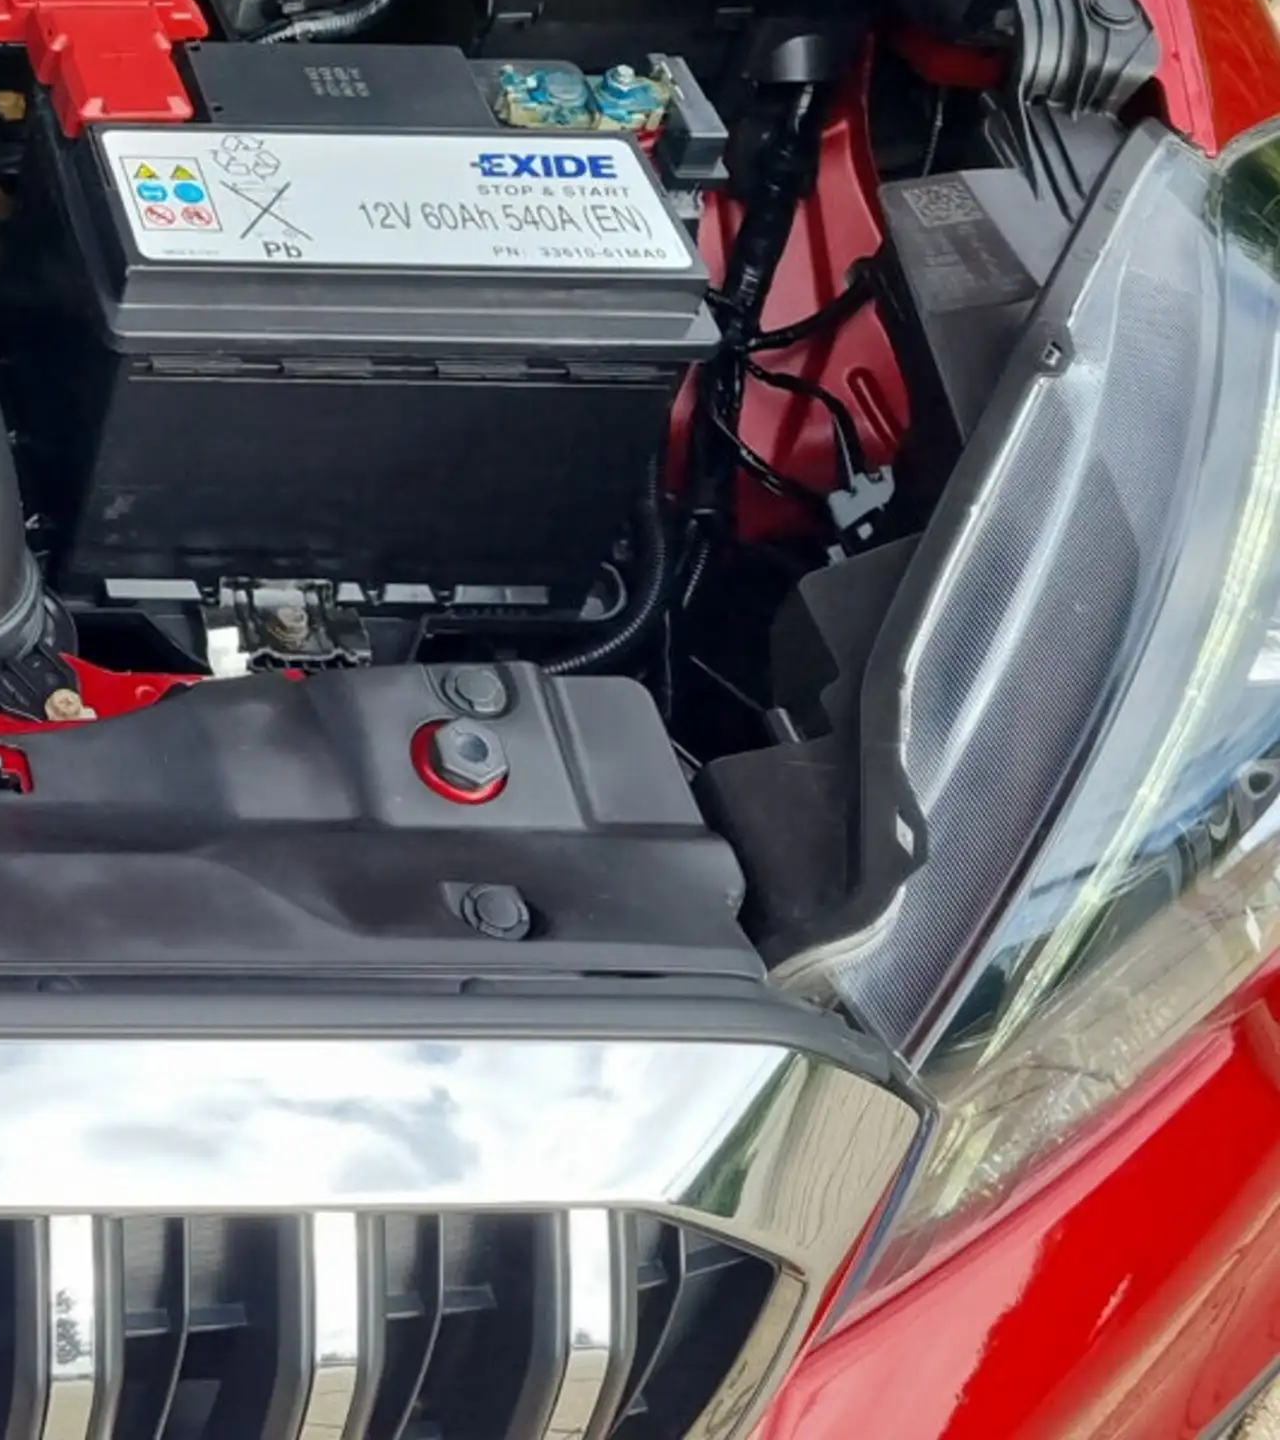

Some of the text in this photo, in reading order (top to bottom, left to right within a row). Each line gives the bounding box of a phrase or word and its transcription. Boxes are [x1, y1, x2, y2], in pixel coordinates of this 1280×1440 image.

[474, 153, 618, 179] EXIDE
[477, 184, 630, 198] STOP & START
[359, 201, 653, 240] 12V 60Ah 540A (EN)
[262, 241, 303, 259] Pb
